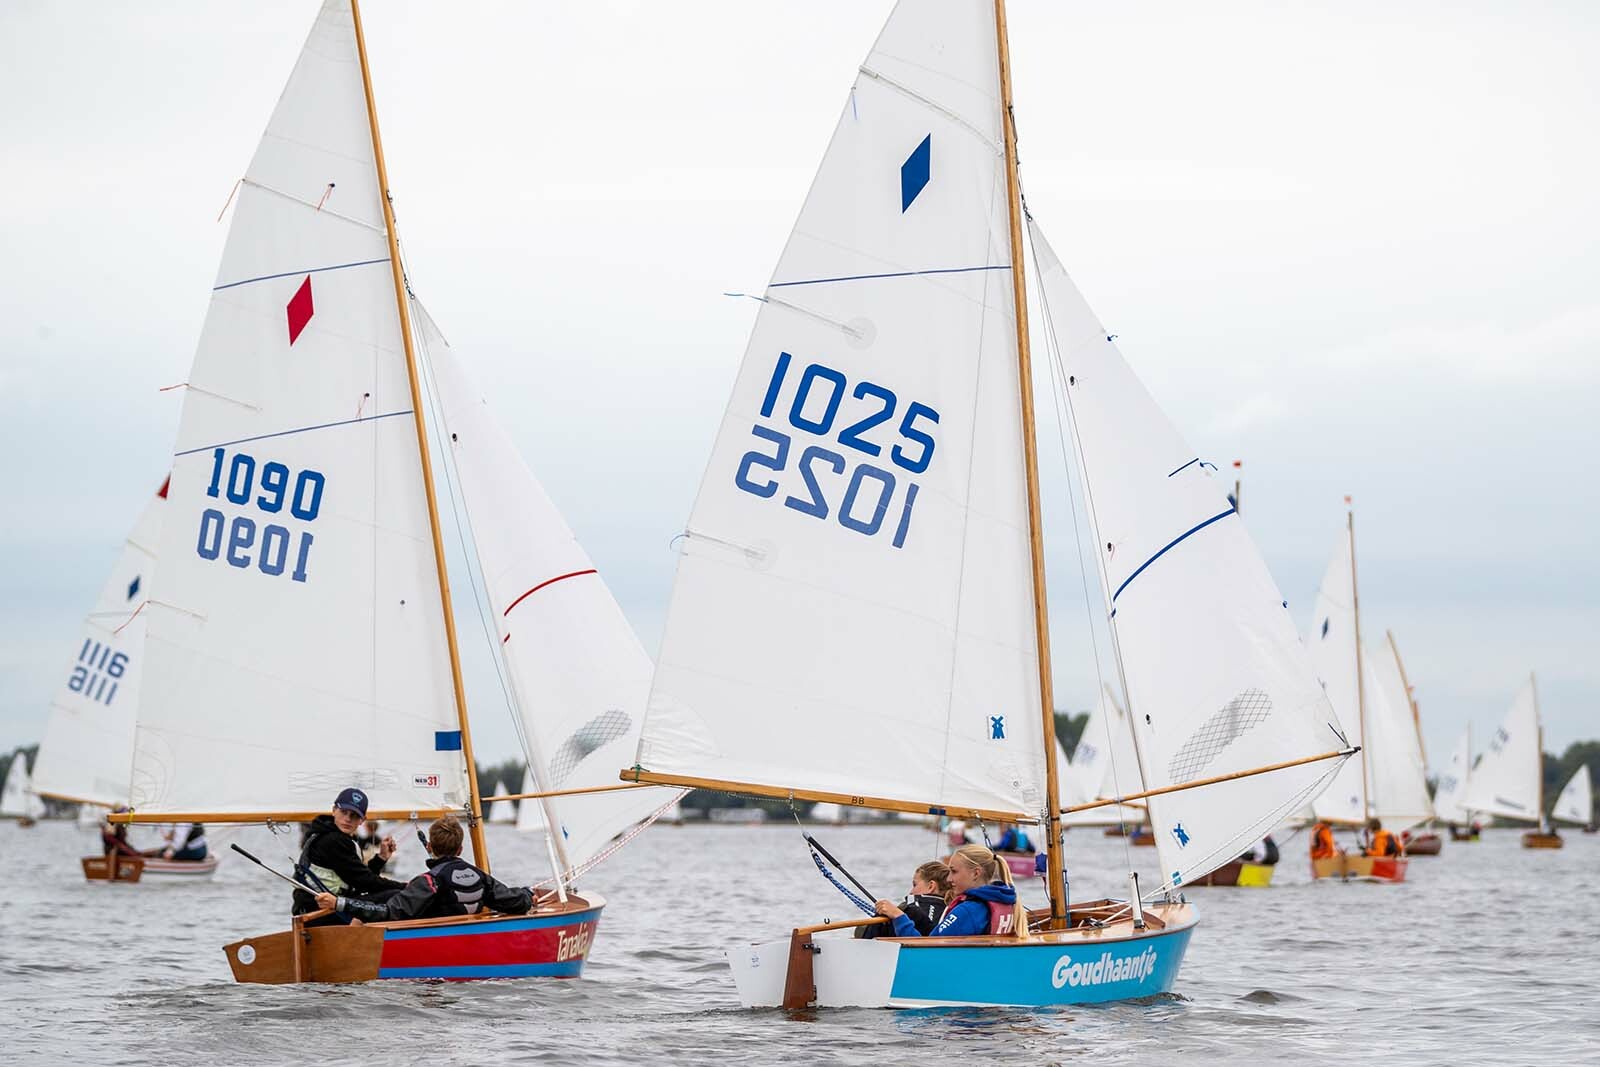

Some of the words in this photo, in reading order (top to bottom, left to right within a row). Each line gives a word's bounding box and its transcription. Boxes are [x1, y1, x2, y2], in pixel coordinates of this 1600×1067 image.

[760, 352, 940, 473] 1025
[207, 448, 325, 521] 1090
[79, 638, 129, 678] 1116
[1052, 945, 1157, 989] Goudhaantje
